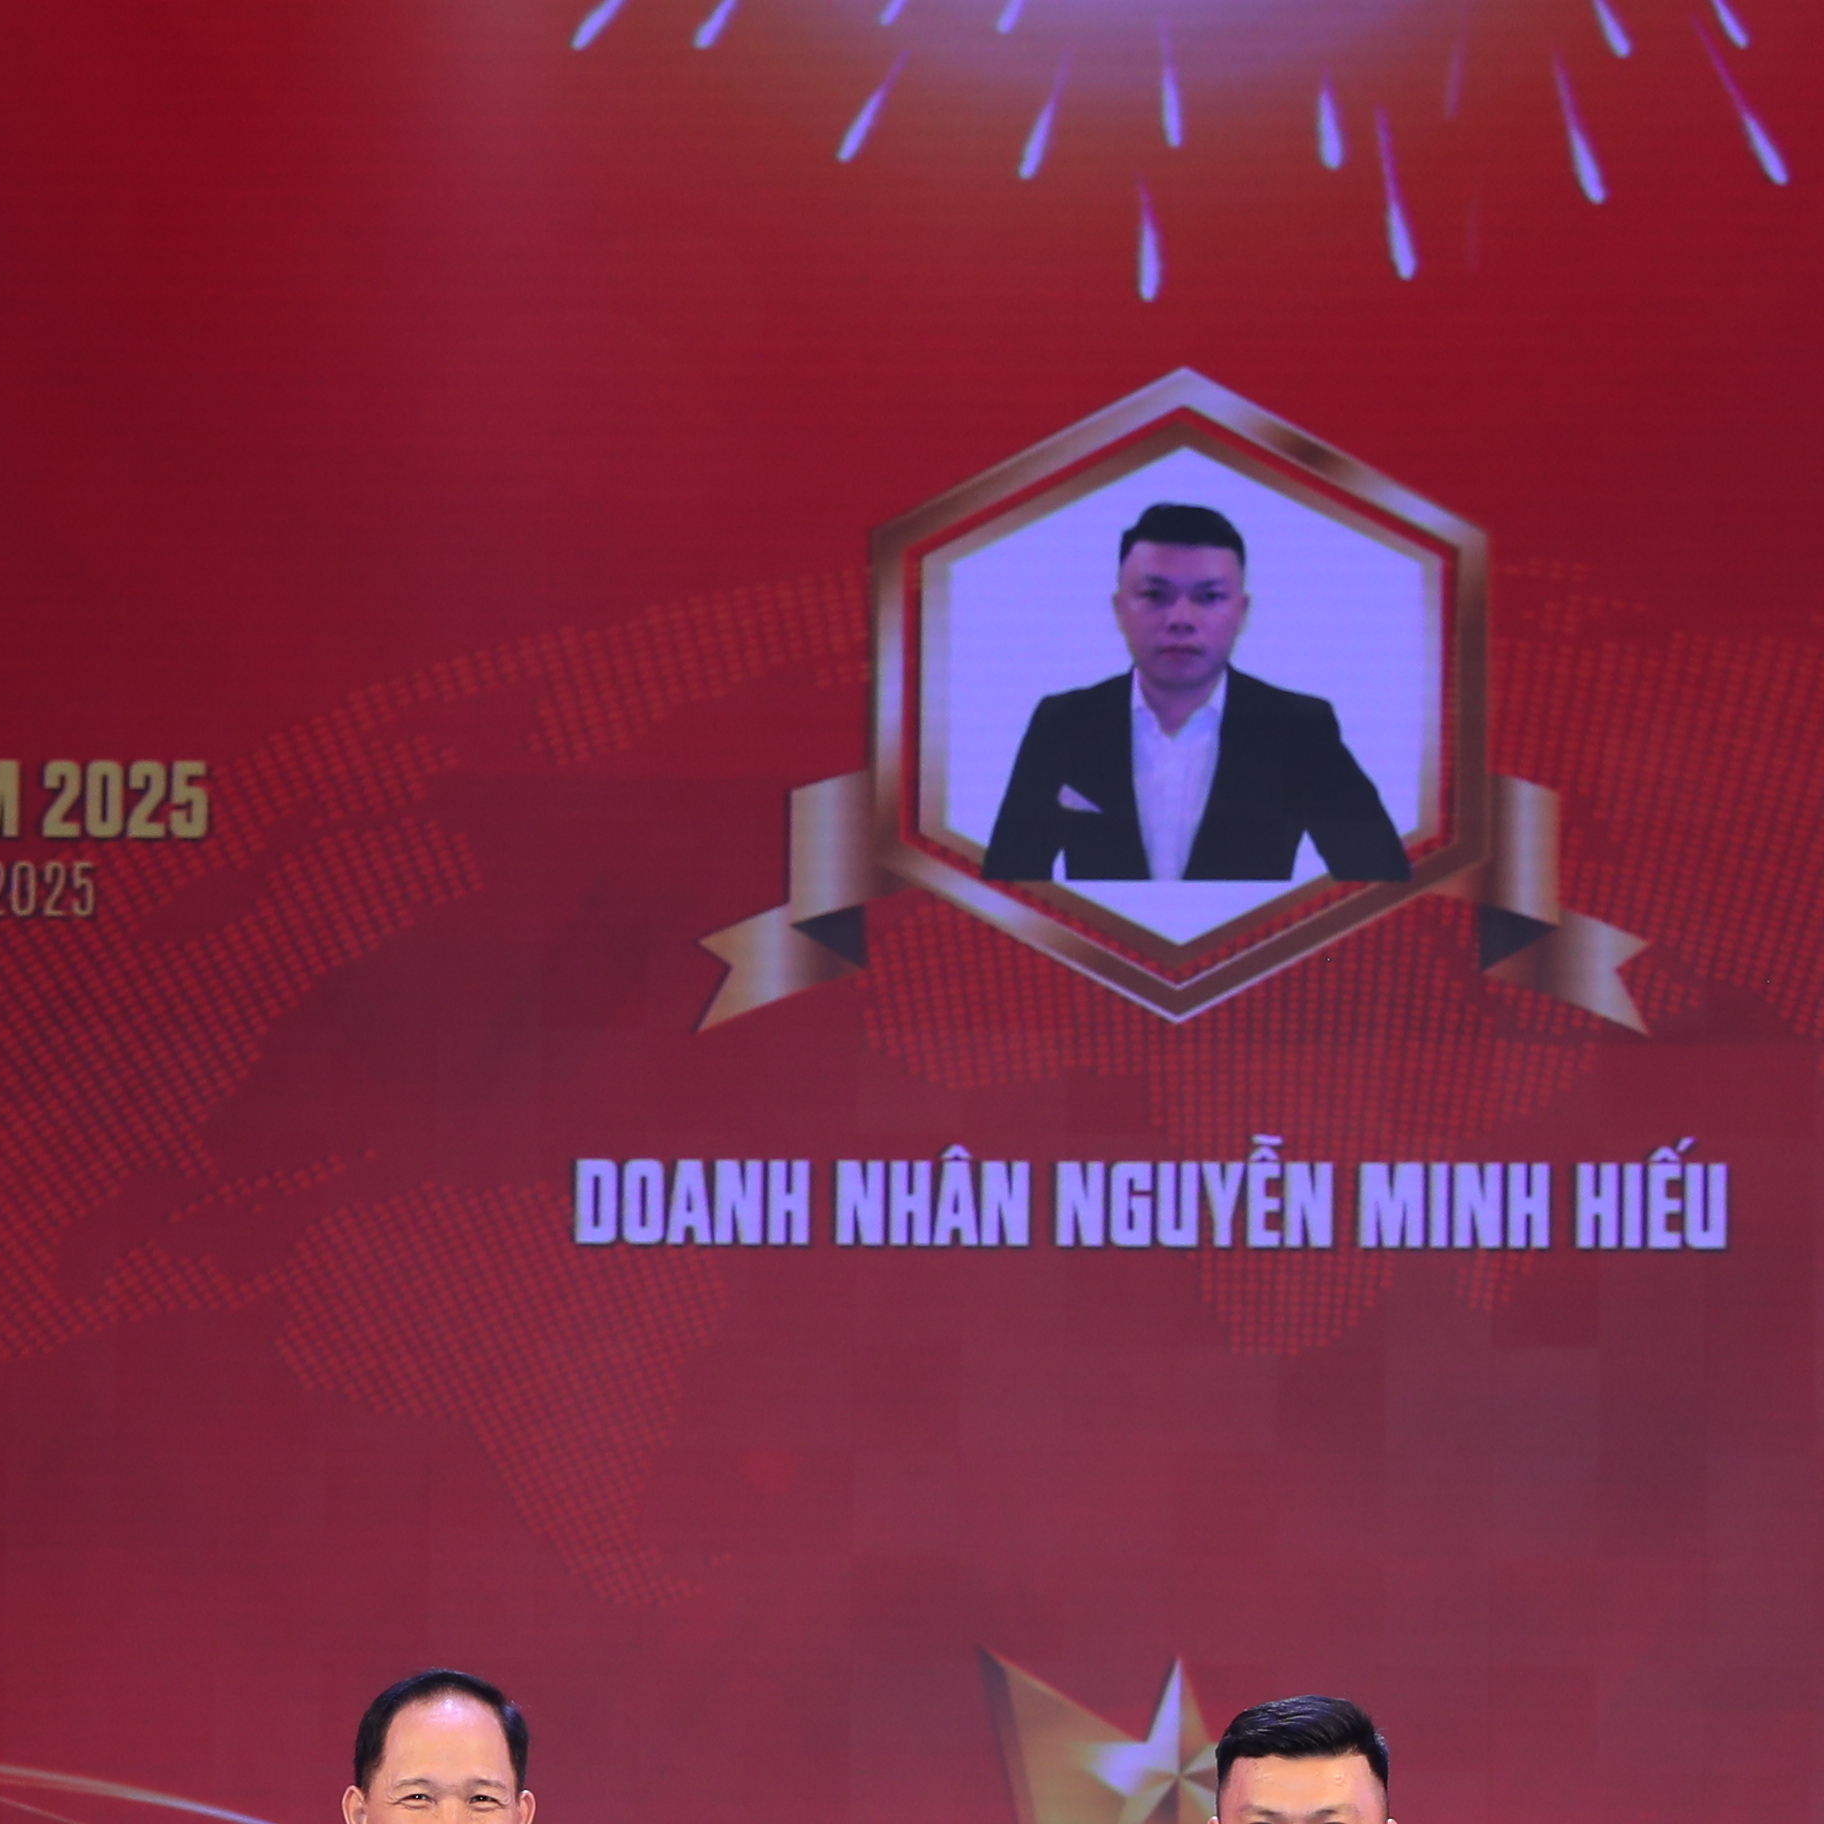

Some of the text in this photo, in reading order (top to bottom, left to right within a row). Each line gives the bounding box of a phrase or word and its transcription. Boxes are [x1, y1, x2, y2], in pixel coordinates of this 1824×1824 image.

[41, 759, 208, 839] 2025
[576, 1134, 1727, 1249] DOANH NHÂN NGUYỄN MINH HIẾU
